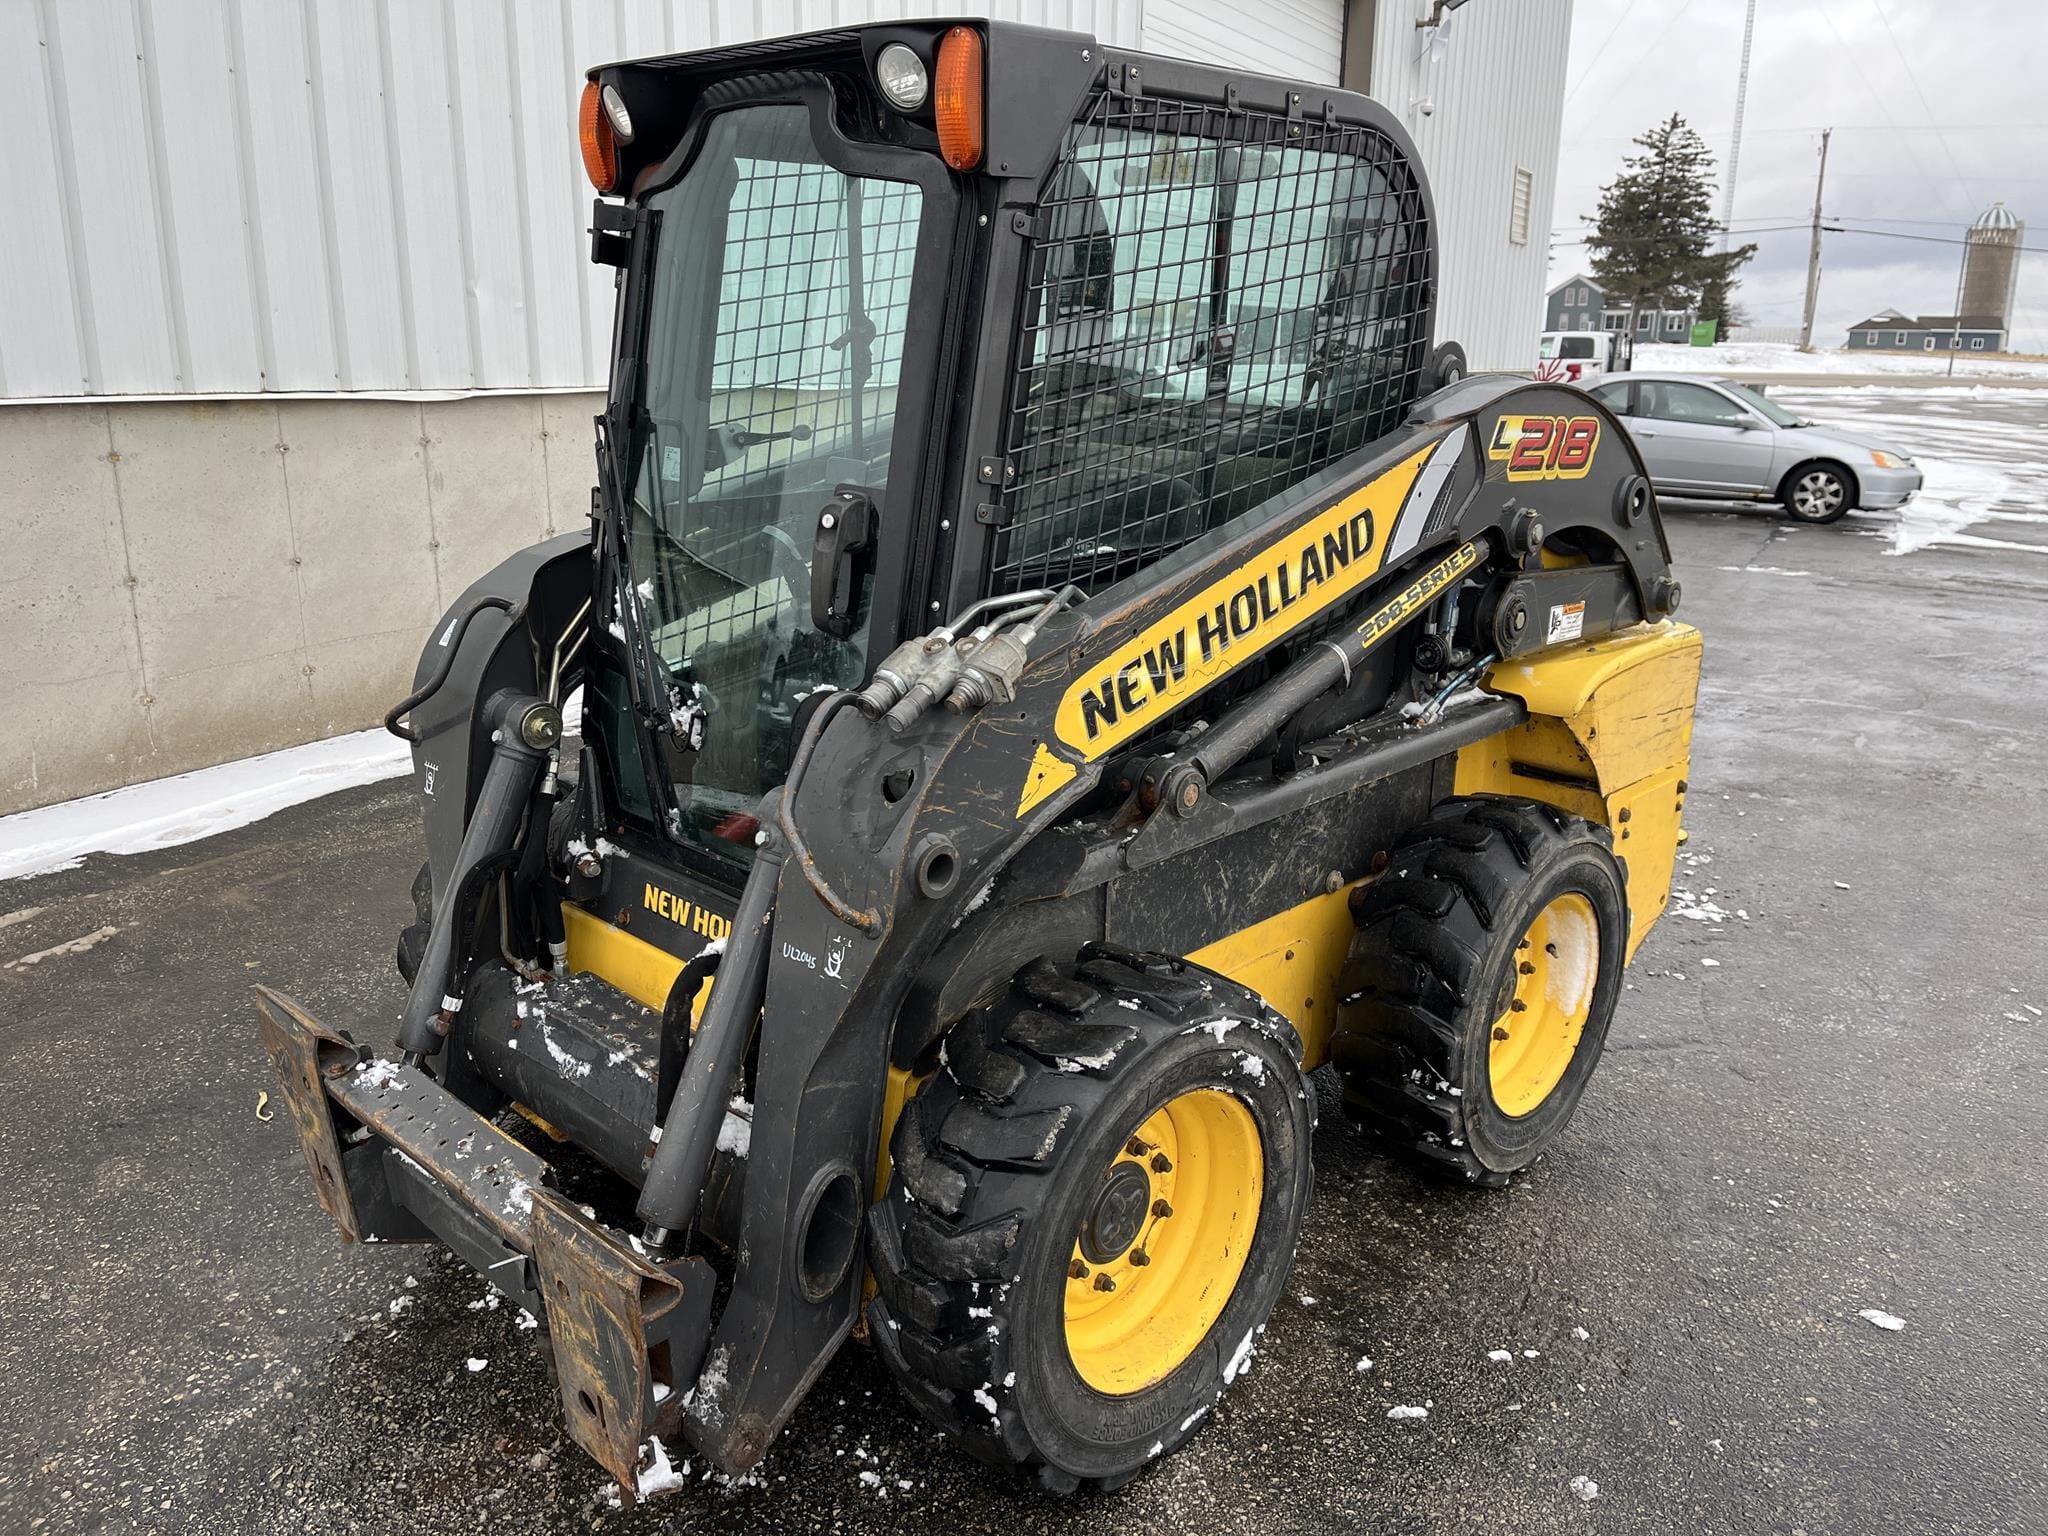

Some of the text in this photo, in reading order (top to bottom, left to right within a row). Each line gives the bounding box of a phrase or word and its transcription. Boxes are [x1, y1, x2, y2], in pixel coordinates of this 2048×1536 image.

[1080, 507, 1376, 742] NEW HOLLAND
[643, 882, 691, 928] NEW
